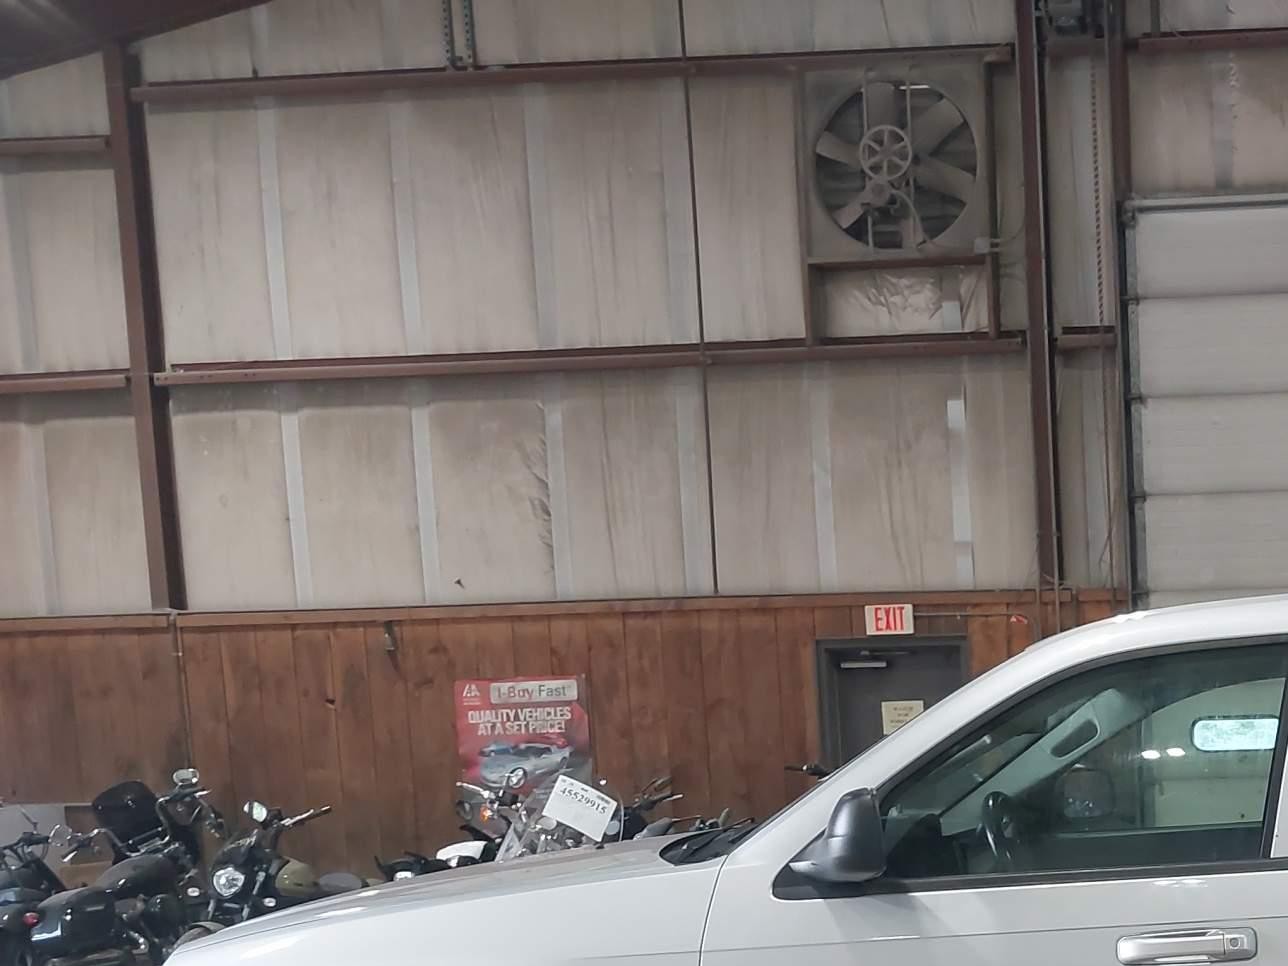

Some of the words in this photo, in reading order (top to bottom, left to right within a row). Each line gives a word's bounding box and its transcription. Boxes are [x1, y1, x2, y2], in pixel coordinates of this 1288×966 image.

[874, 606, 905, 631] EXIT
[497, 686, 534, 699] I-Buy
[538, 684, 567, 697] Fast
[468, 708, 516, 723] QUALITY
[517, 706, 572, 721] VEHICLES
[477, 723, 492, 736] AT
[494, 722, 505, 735] A
[505, 721, 527, 735] SET
[529, 720, 565, 734] PRICE!
[560, 787, 608, 814] 45529915
